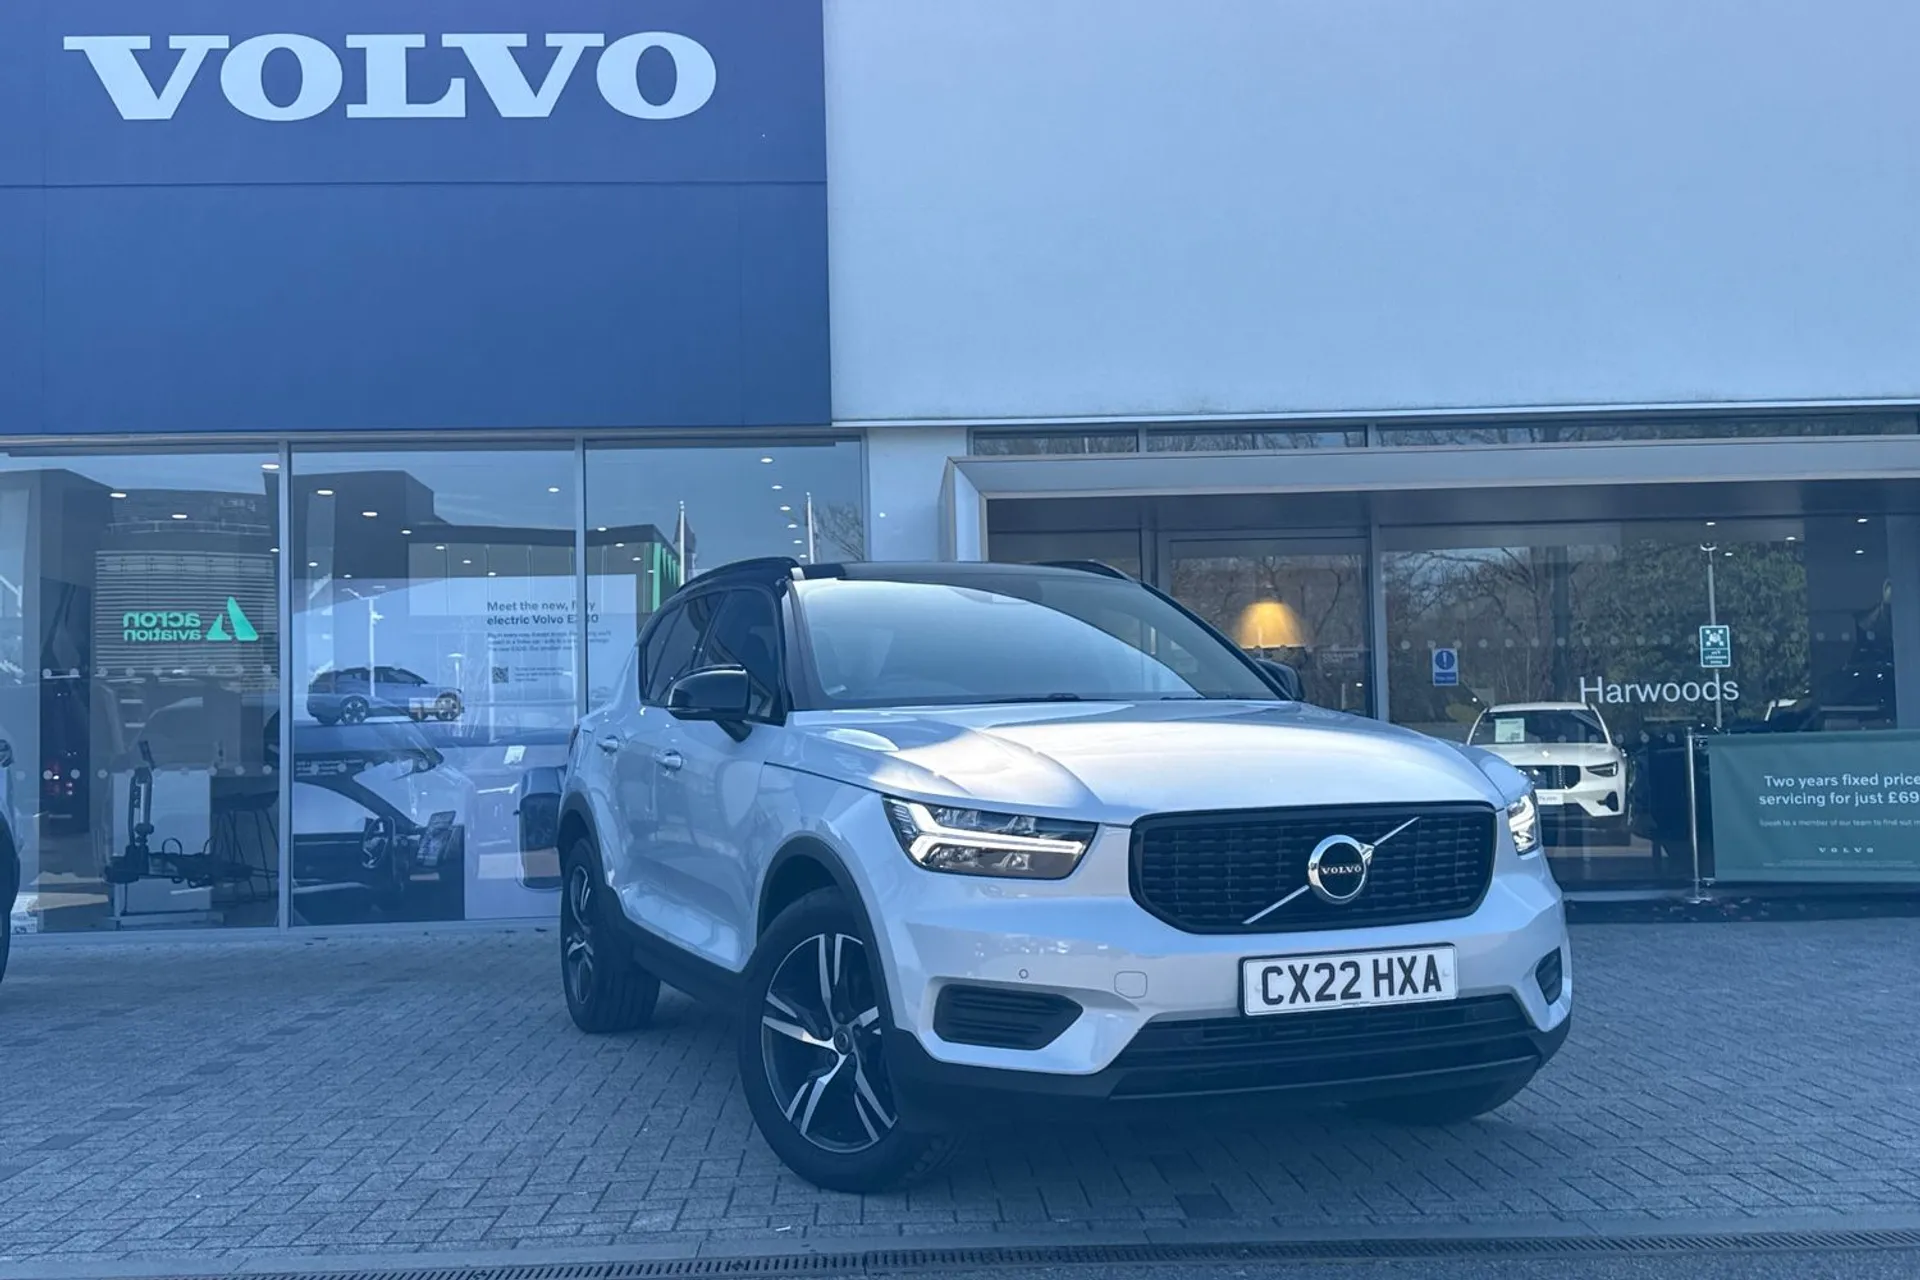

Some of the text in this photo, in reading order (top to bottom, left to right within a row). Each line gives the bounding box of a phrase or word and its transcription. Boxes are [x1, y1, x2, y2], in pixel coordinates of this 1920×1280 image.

[63, 31, 717, 121] VOLVO
[487, 601, 517, 612] Meet
[520, 600, 539, 611] the
[542, 601, 568, 612] new,
[487, 614, 530, 626] electric
[532, 614, 564, 625] Volvo
[1580, 676, 1740, 703] Harwoods
[1764, 772, 1920, 789] Two years fixed price
[1759, 792, 1826, 807] servicing
[1830, 792, 1851, 804] for
[1855, 791, 1884, 807] just
[1321, 865, 1362, 875] VOLVO
[1261, 954, 1443, 1006] CX22 HXA
